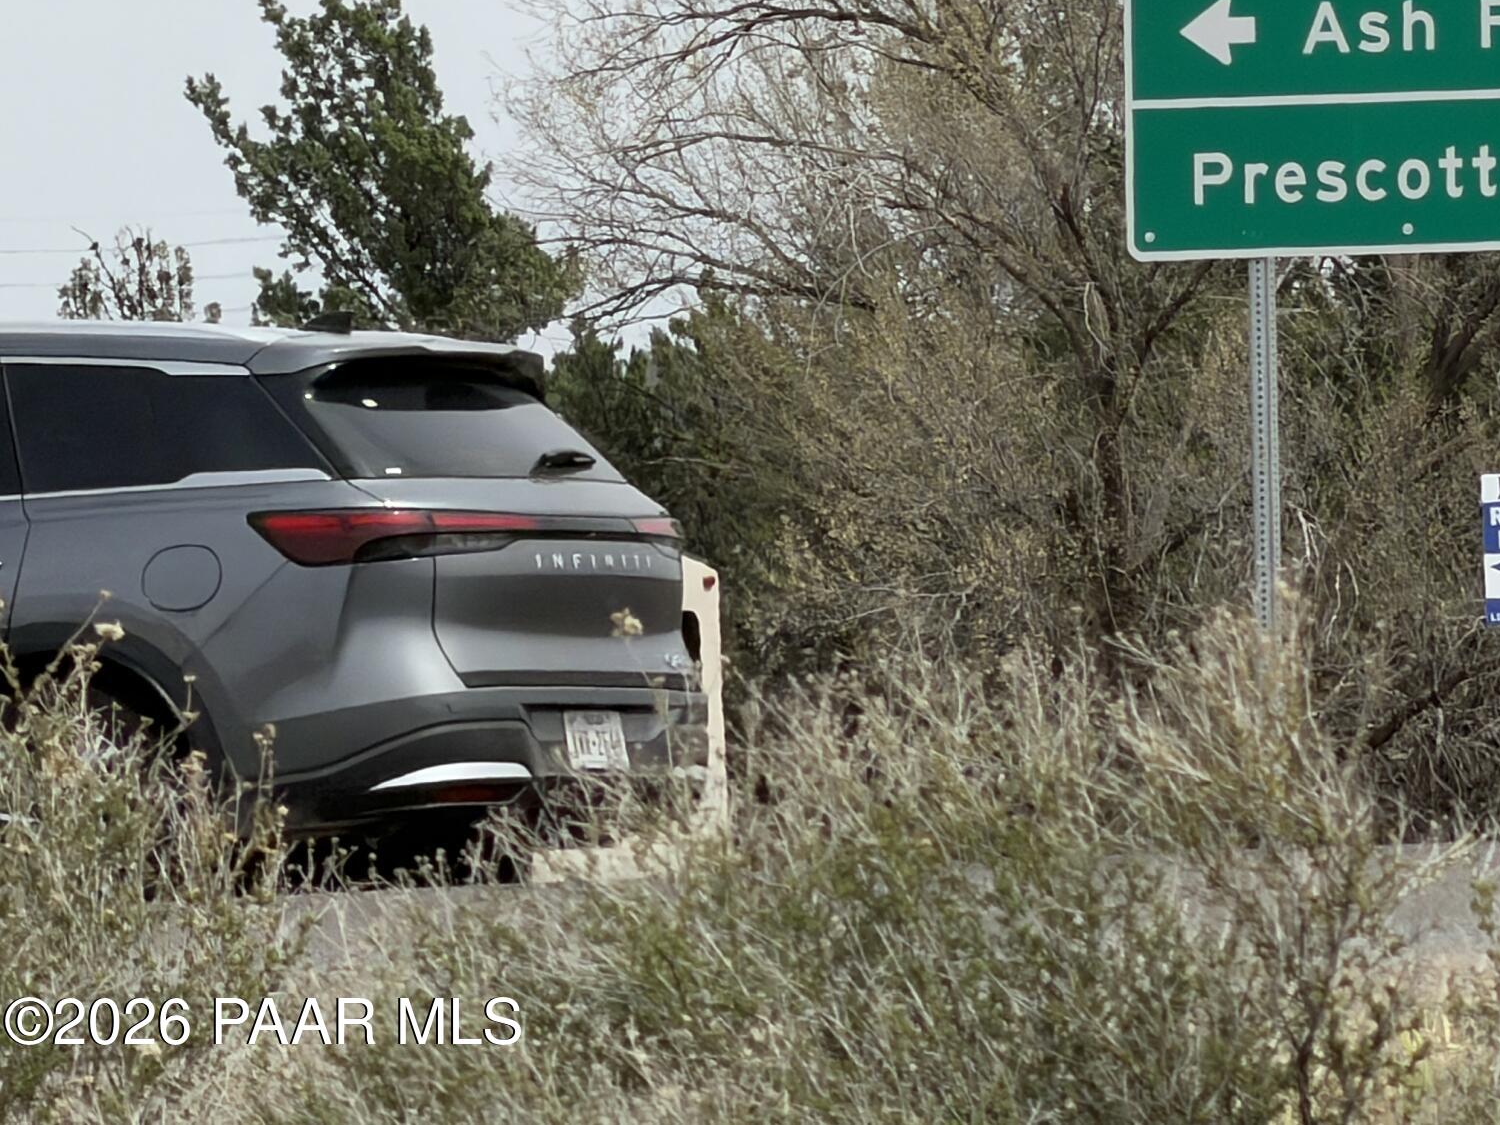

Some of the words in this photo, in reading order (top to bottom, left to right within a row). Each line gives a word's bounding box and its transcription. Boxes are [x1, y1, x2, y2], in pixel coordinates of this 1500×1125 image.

[1302, 0, 1435, 55] Ash
[1192, 144, 1498, 206] Prescott
[535, 553, 651, 569] INFINITI
